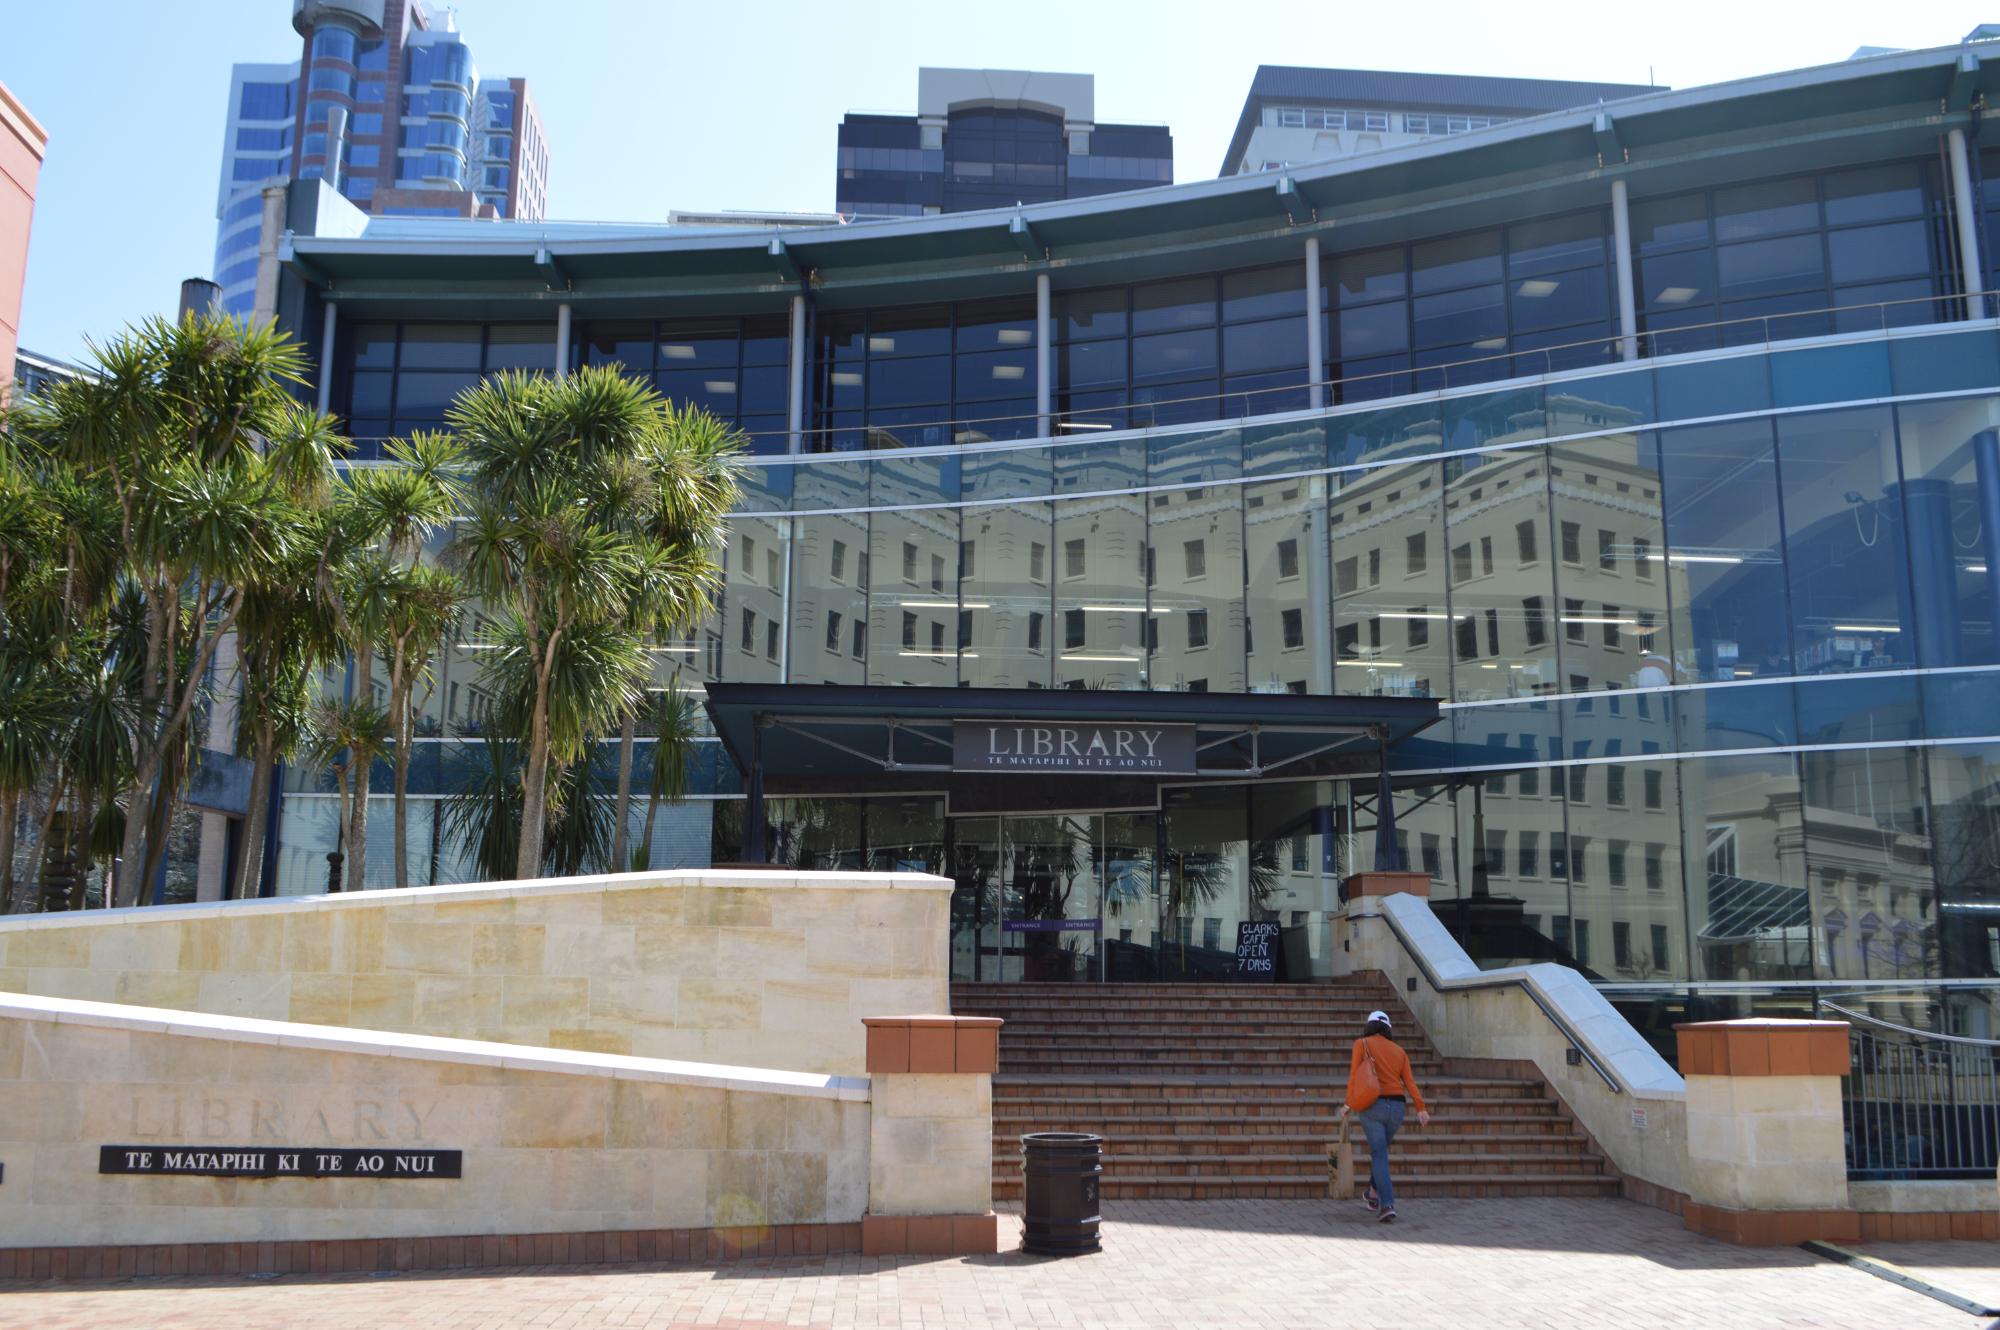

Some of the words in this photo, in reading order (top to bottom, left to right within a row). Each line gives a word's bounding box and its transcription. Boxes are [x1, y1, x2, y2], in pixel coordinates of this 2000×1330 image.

[988, 727, 1163, 758] LIBRARY
[1010, 757, 1070, 765] MATAPIHI
[1077, 758, 1090, 766] KI
[1097, 758, 1112, 766] TE
[1119, 759, 1134, 767] AO
[1141, 759, 1162, 767] NUI
[1238, 944, 1268, 957] OPEN
[1238, 958, 1246, 971] 7
[1247, 958, 1272, 971] DAYS
[131, 1096, 439, 1141] LIBRARY
[126, 1152, 152, 1168] TE
[163, 1152, 266, 1170] MATAPIHI
[278, 1154, 300, 1171] KI
[316, 1155, 342, 1171] TE
[355, 1155, 384, 1172] AO
[395, 1156, 436, 1173] NUI
